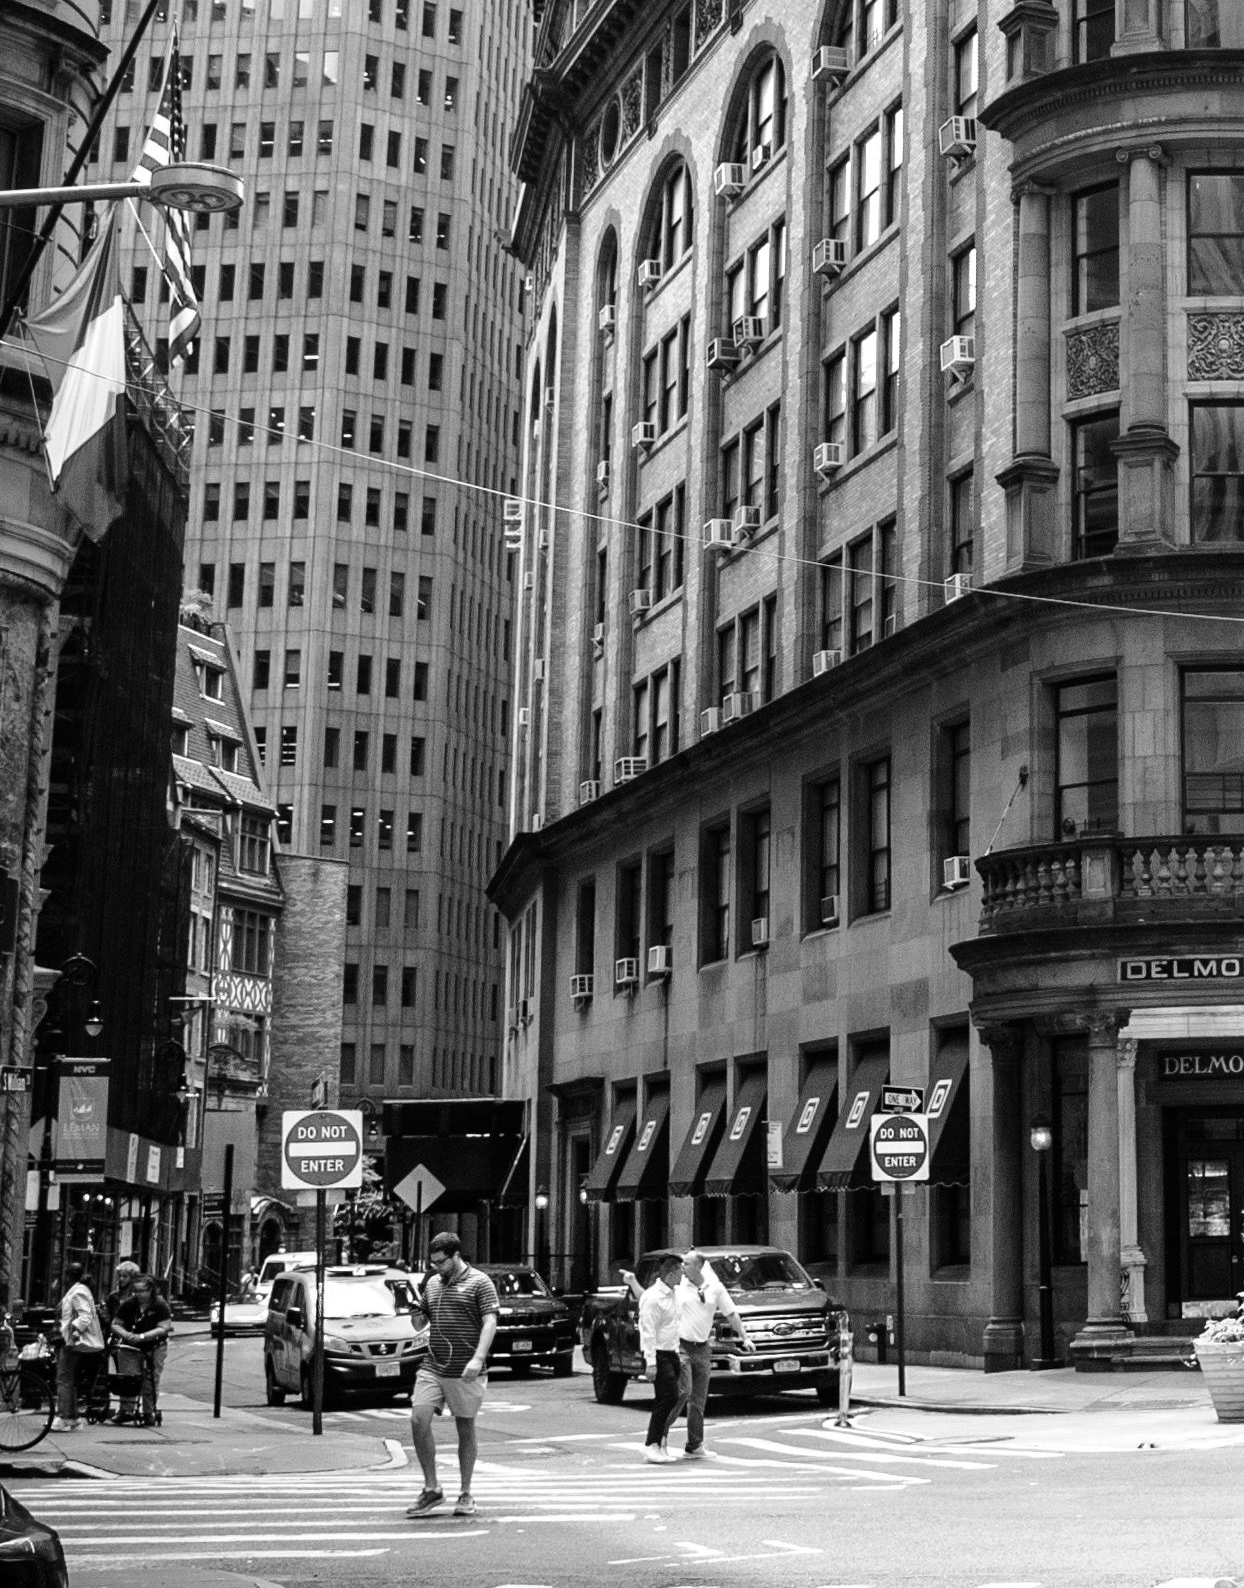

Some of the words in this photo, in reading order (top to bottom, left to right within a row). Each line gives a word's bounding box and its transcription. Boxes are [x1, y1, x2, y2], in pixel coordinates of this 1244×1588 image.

[888, 1093, 901, 1104] ONE
[905, 1094, 918, 1105] WAY
[298, 1127, 317, 1139] DO
[321, 1126, 347, 1138] NOT
[880, 1128, 894, 1139] DO
[899, 1127, 919, 1138] NOT
[301, 1159, 344, 1172] ENTER
[885, 1156, 916, 1167] ENTER
